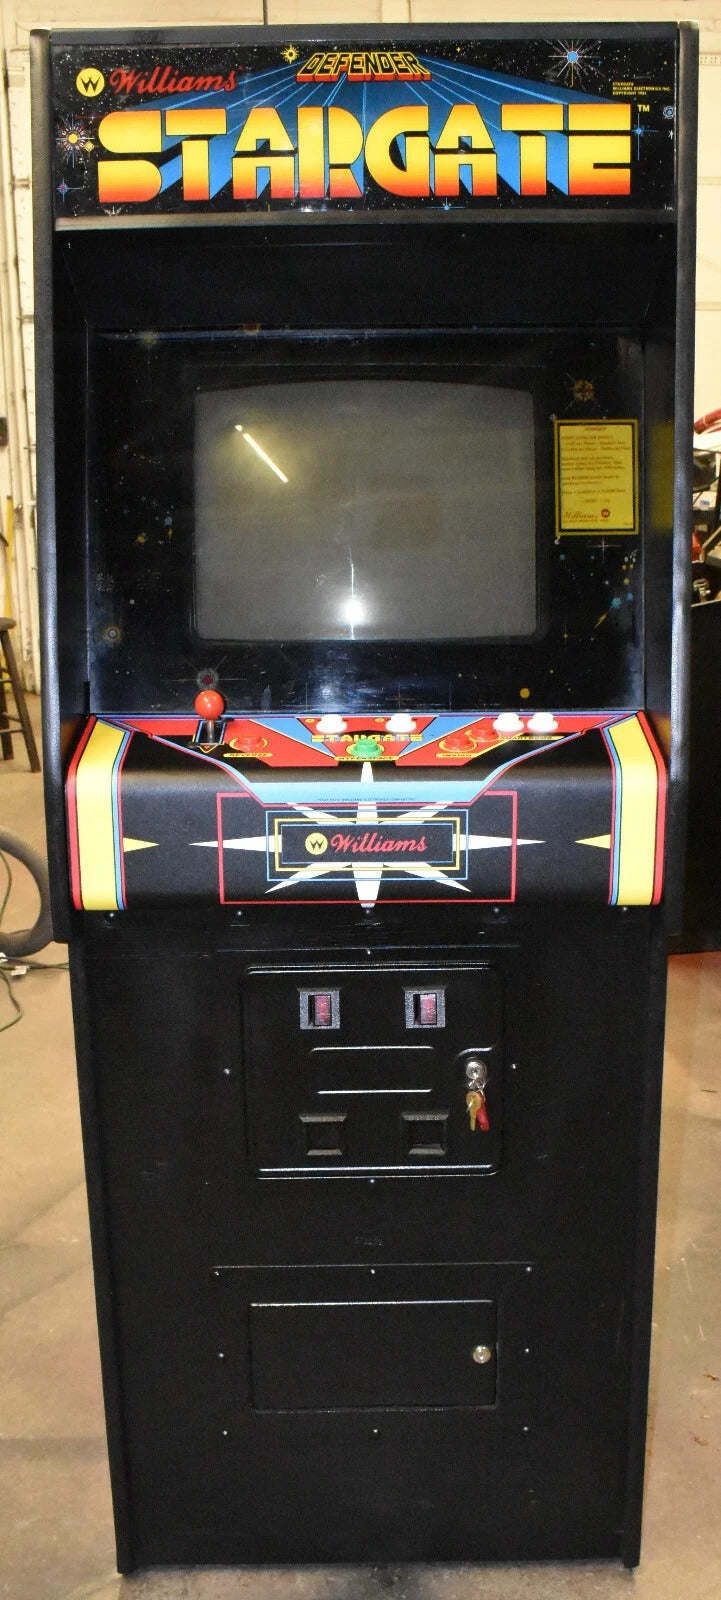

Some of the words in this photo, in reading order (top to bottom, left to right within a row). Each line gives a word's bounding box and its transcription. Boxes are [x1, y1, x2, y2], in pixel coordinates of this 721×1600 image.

[109, 65, 239, 95] Williams
[296, 52, 431, 82] DEFENDER
[637, 104, 650, 112] TM
[97, 103, 630, 203] STARGATE
[330, 832, 428, 854] Williams
